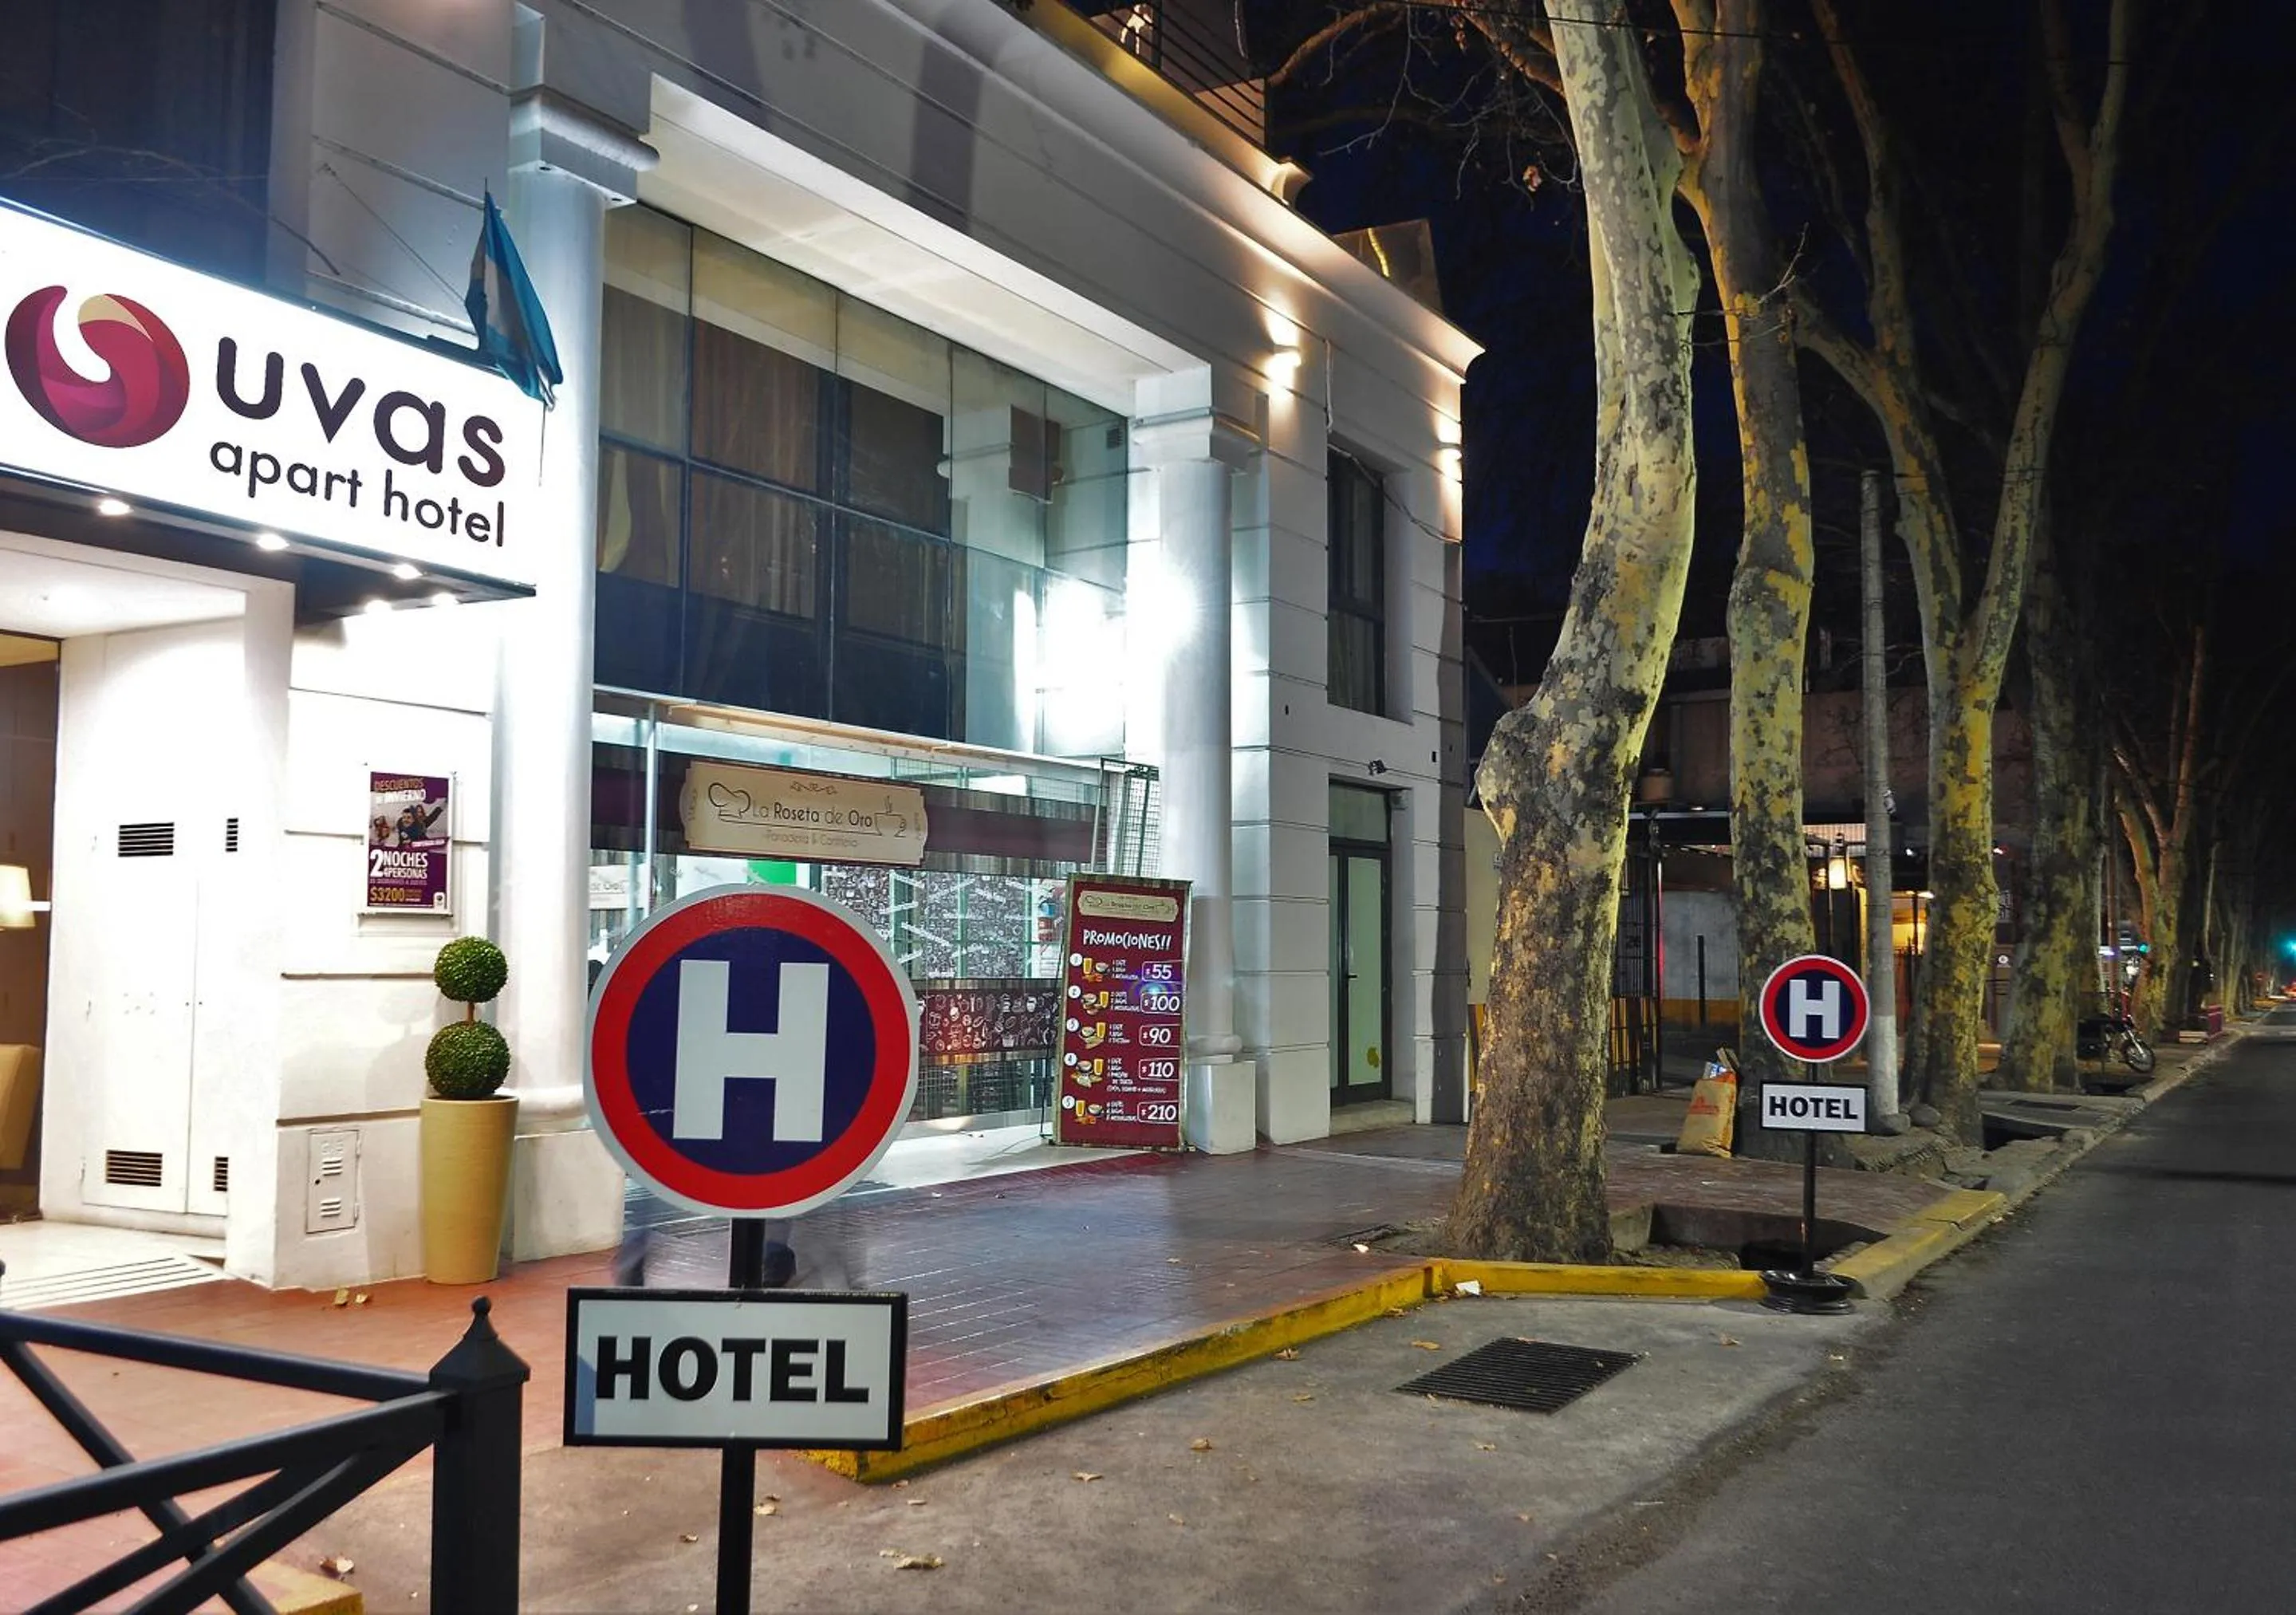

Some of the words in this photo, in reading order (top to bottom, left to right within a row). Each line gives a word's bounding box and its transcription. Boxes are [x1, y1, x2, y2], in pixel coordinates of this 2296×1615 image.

[216, 337, 506, 487] uvas
[210, 441, 362, 506] apart
[384, 469, 504, 546] hotel
[753, 803, 770, 818] La
[774, 802, 820, 823] Roseta
[825, 807, 843, 825] de
[849, 809, 873, 827] Oro
[370, 849, 384, 877] 2
[384, 851, 428, 868] NOCHES
[370, 886, 405, 902] $3200
[1083, 929, 1172, 951] PROMOCIONES!!
[1789, 979, 1841, 1039] H
[672, 959, 829, 1142] H
[1769, 1096, 1858, 1120] HOTEL
[595, 1335, 869, 1403] HOTEL
